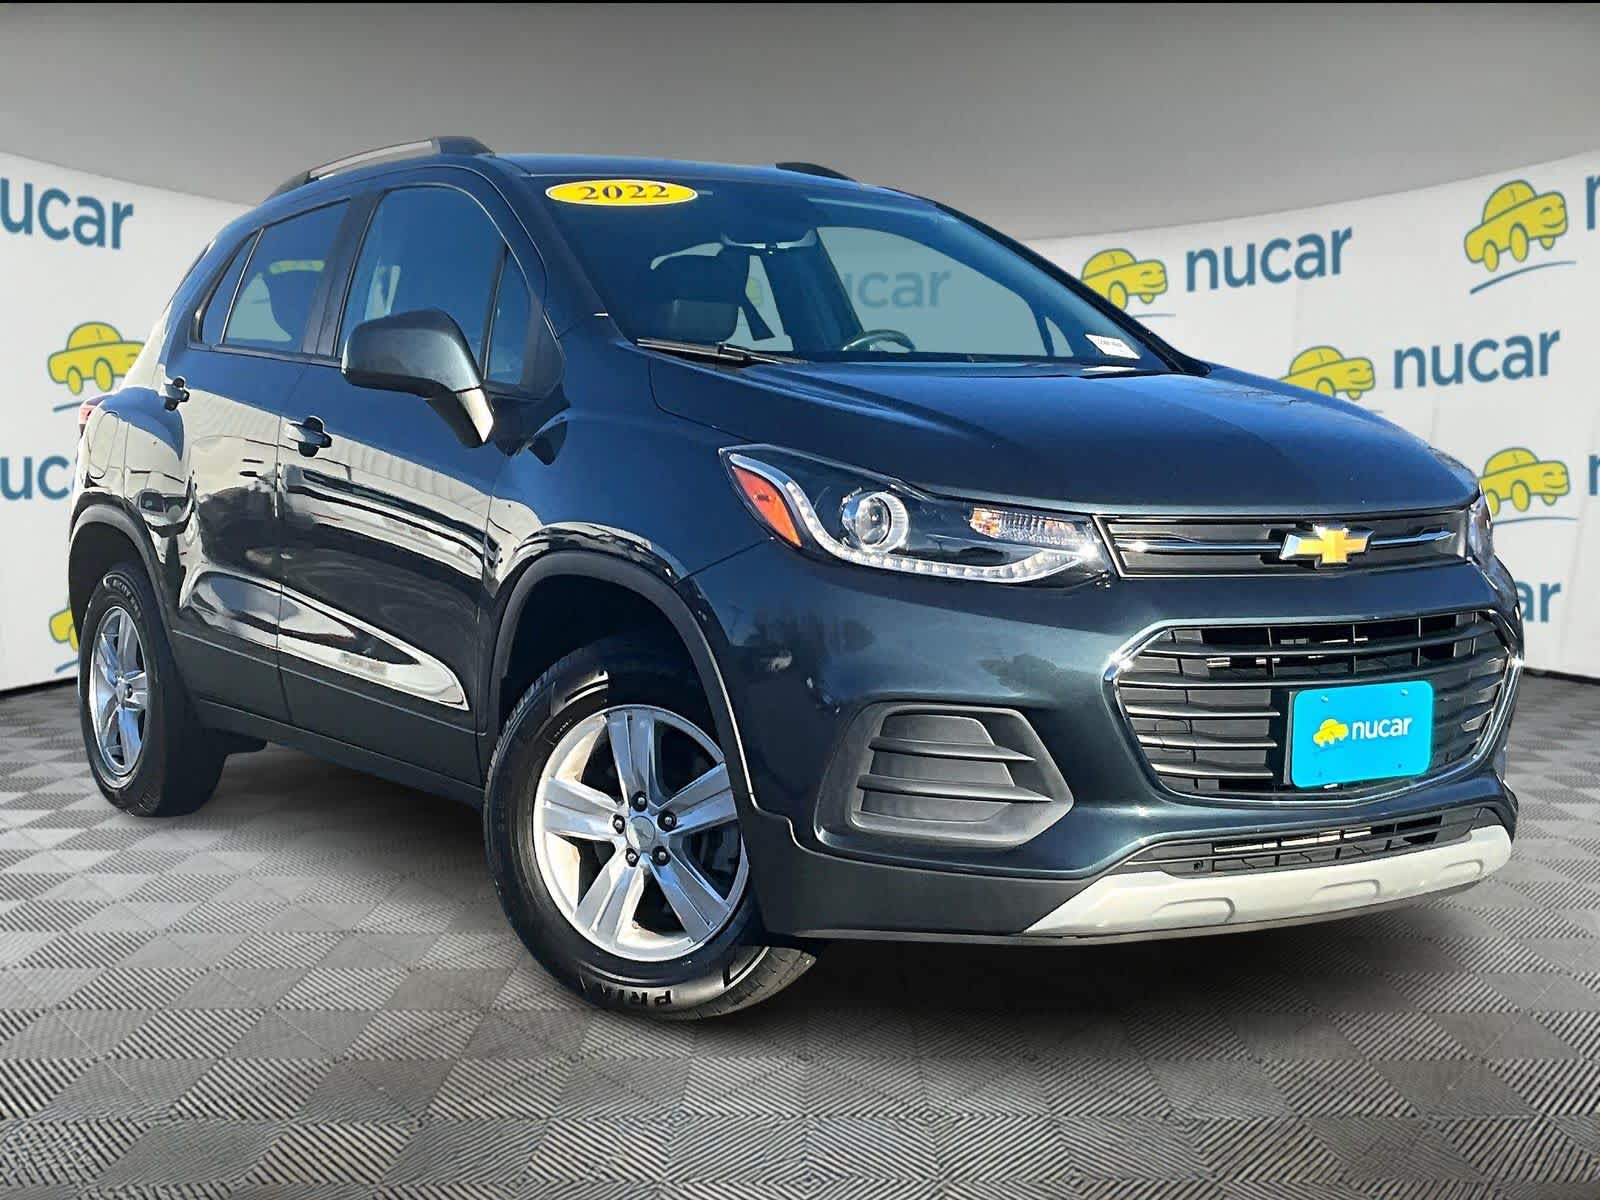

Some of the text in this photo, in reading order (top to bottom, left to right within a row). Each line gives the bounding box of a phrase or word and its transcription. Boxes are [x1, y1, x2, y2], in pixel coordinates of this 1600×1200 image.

[578, 184, 670, 201] 2022
[1185, 226, 1353, 293] nucar
[1394, 329, 1561, 390] nucar
[1352, 717, 1413, 741] nucar
